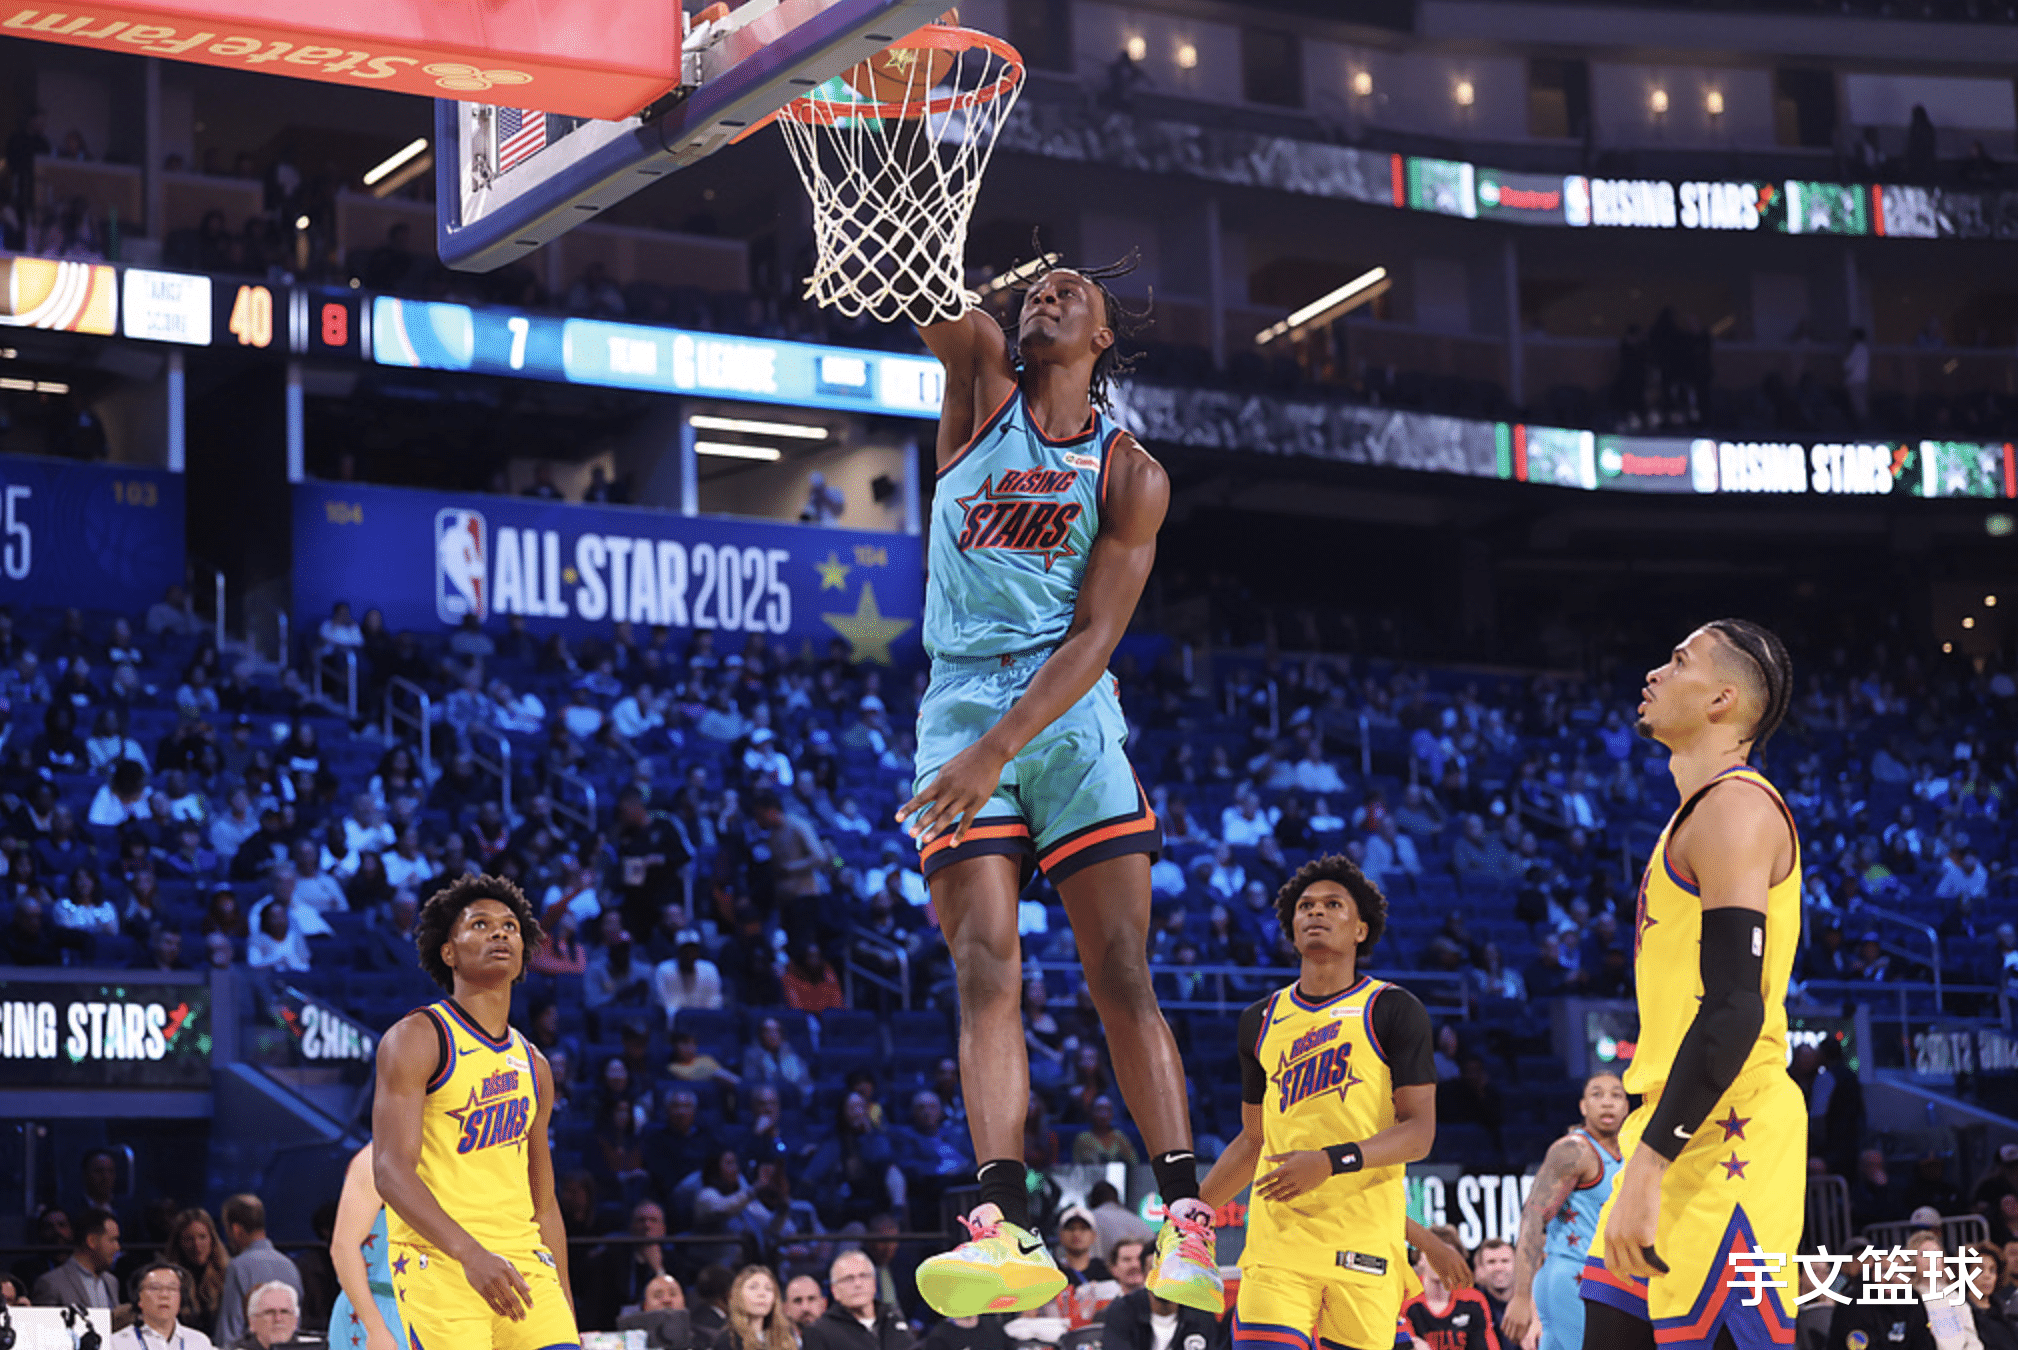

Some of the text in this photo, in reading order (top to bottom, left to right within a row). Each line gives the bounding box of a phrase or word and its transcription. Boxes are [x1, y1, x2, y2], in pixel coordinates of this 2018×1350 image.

[2, 8, 420, 79] State Farm
[1591, 179, 1677, 228] RISING
[1679, 181, 1760, 230] STARS
[229, 285, 272, 347] 40
[321, 303, 348, 346] 8
[508, 317, 529, 369] 7
[994, 465, 1079, 494] RISING
[1720, 442, 1808, 493] RISING
[1811, 443, 1894, 494] STARS
[957, 501, 1083, 553] STARS
[492, 527, 791, 634] ALL STAR 2025
[0, 1001, 167, 1060] ING STARS
[1280, 1042, 1352, 1114] STARS
[457, 1096, 529, 1155] STARS
